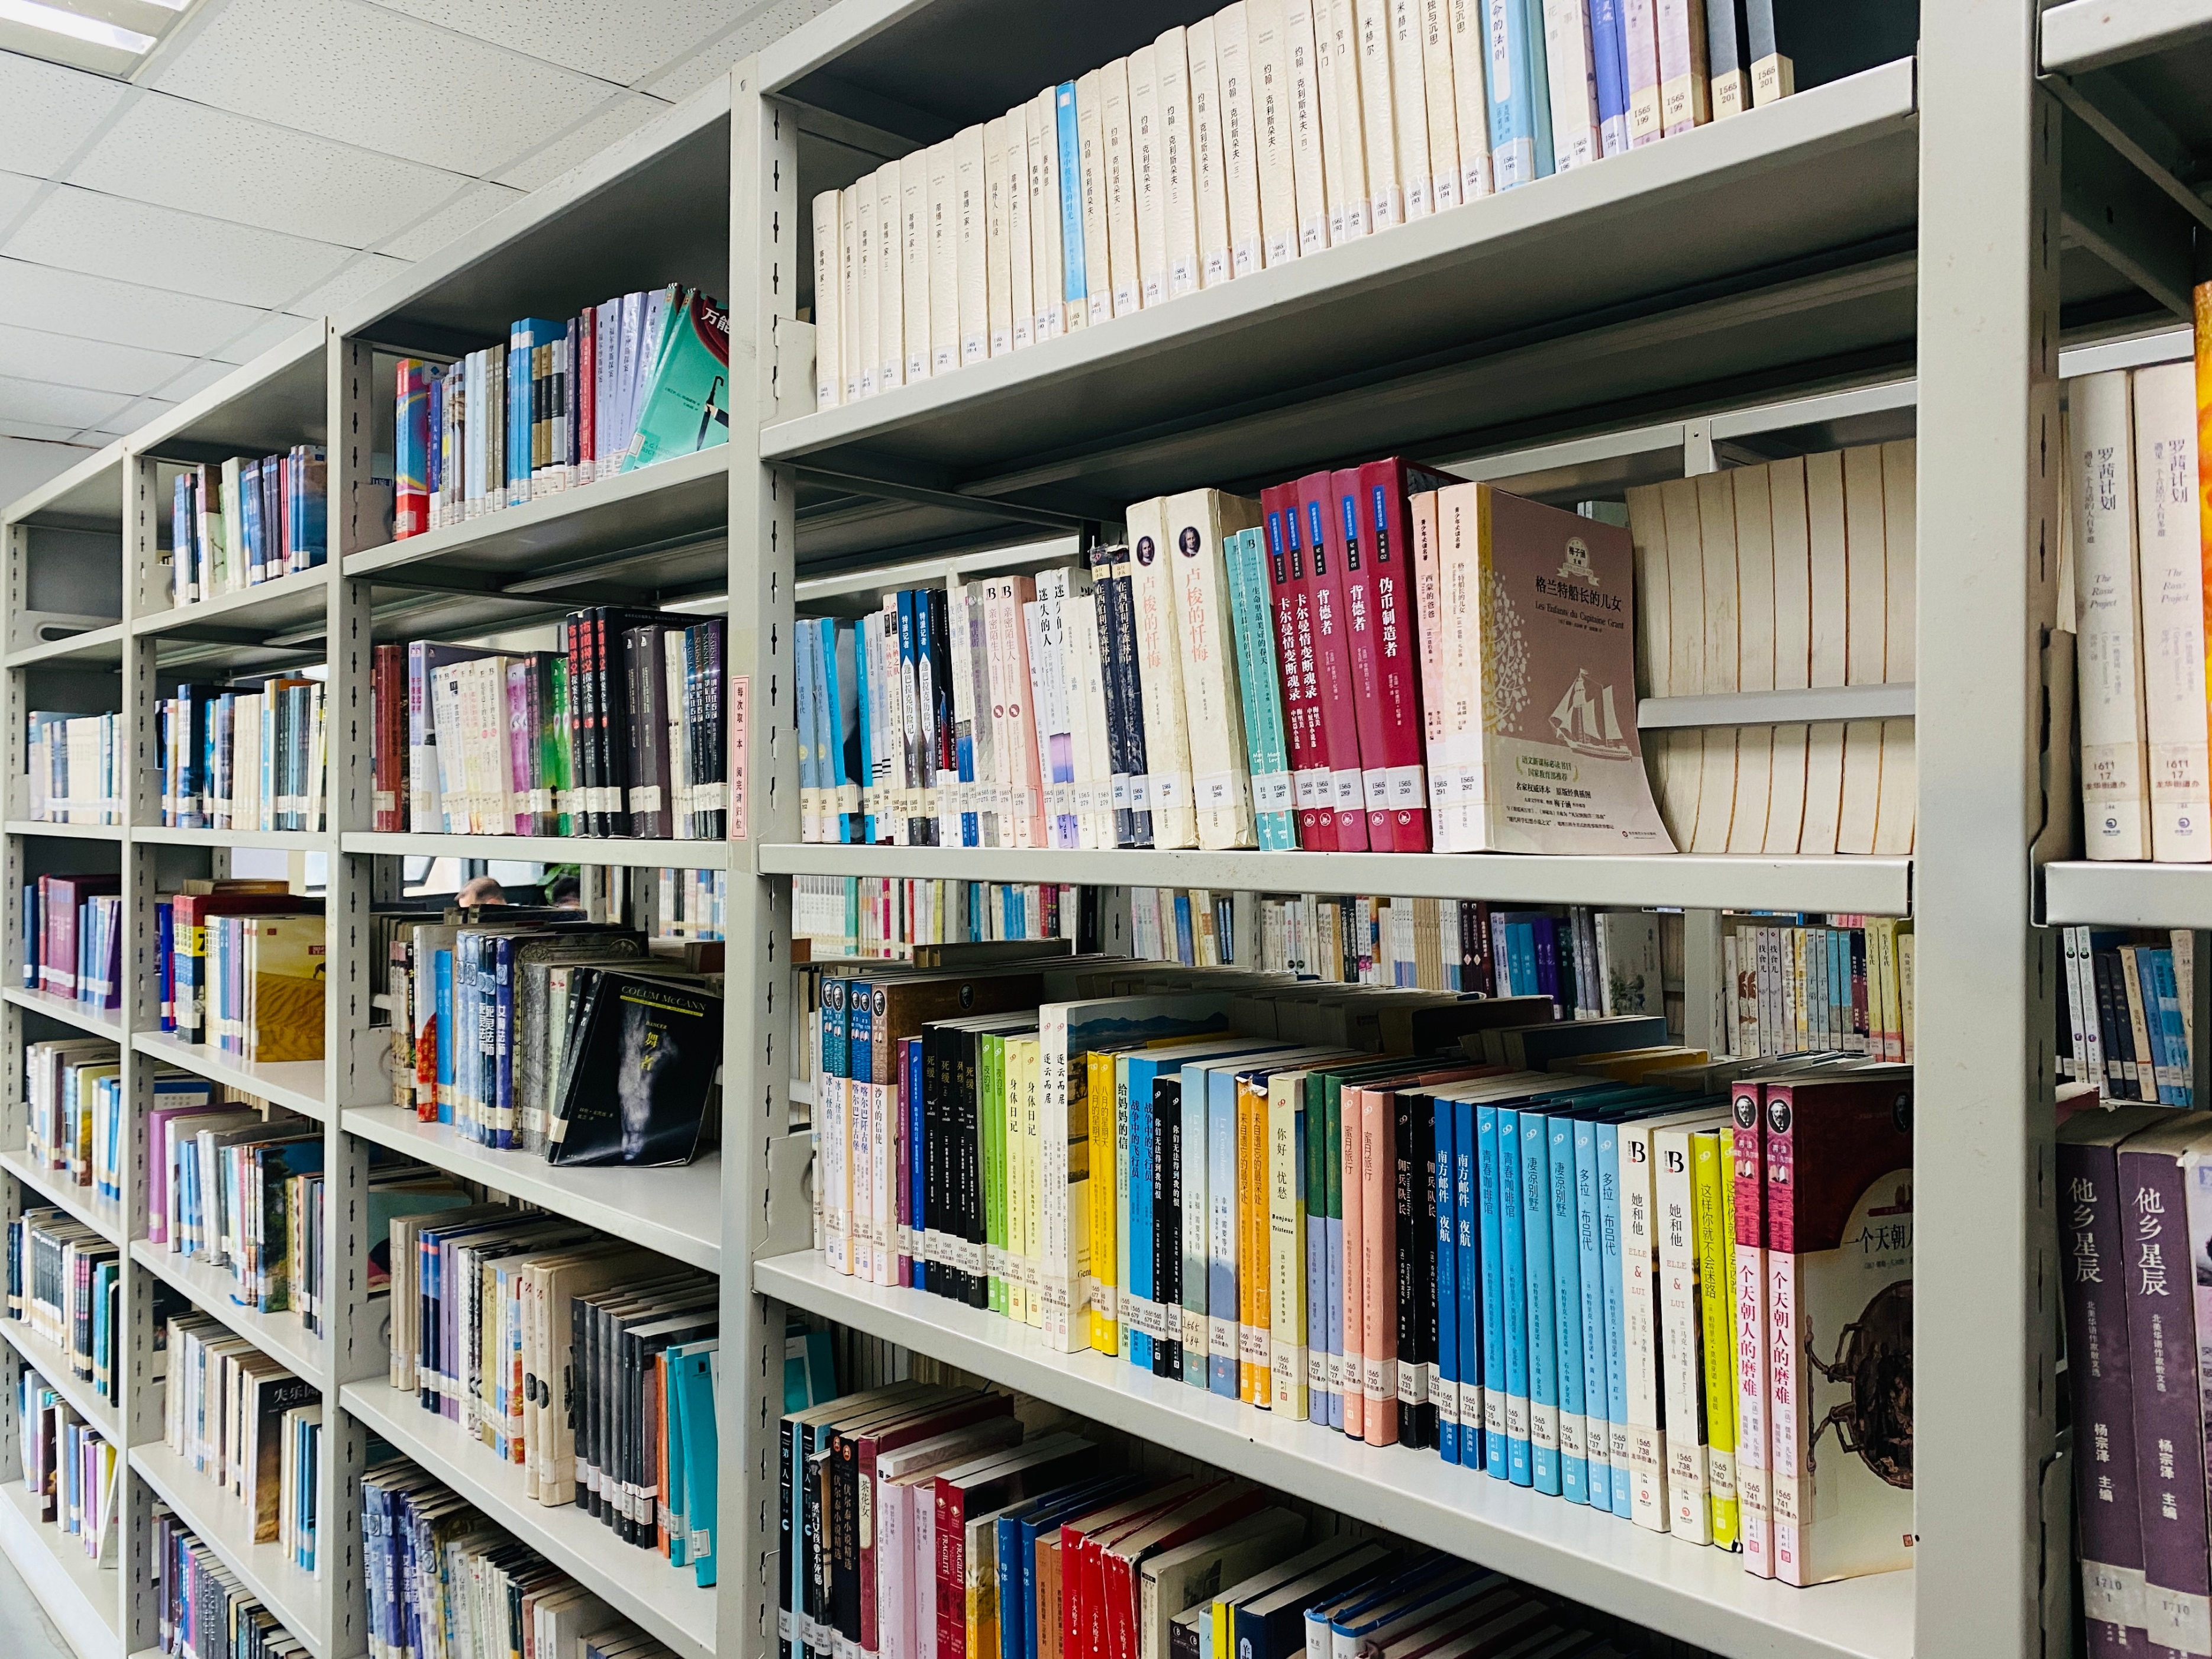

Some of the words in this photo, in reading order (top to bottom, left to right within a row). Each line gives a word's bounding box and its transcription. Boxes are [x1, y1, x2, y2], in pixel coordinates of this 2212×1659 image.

[1722, 93, 1735, 104] 201
[1760, 78, 1773, 88] 201
[1636, 115, 1649, 126] 199
[1670, 103, 1683, 114] 199
[2098, 447, 2116, 511] 罗茜计划
[2168, 439, 2188, 503] 罗茜计划
[1569, 546, 1586, 559] 梅子涵
[2166, 568, 2182, 577] The
[1424, 574, 1435, 619] 西蒙的爸爸
[1535, 575, 1622, 613] 格兰特船长的儿女
[2092, 586, 2114, 596] Rosie
[2095, 573, 2111, 583] The
[2161, 593, 2190, 603] Project
[1039, 589, 1052, 648] 迷失的人
[1118, 581, 1132, 666] 在西伯利亚森林中
[1142, 576, 1161, 669] 卢梭的忏悔
[1186, 567, 1209, 663] 卢梭的忏悔
[1317, 589, 1333, 636] 背德者
[1349, 585, 1366, 632] 背德者
[1379, 577, 1397, 658] 伪币制造者
[1535, 601, 1545, 611] Les
[1546, 603, 1568, 617] Enfants
[1570, 609, 1578, 619] du
[1580, 611, 1606, 627] Capitaine
[1607, 618, 1625, 630] Grant
[2090, 599, 2117, 609] Project
[989, 609, 1000, 662] 亲密陌生人
[1004, 606, 1016, 661] 亲密陌生人
[1096, 584, 1110, 666] 在西伯利亚森林中
[1252, 586, 1268, 665] 生命里最美好的春天
[1278, 597, 1301, 701] 卡尔曼情变断魂录
[1294, 593, 1317, 699] 卡尔曼情变断魂录
[1522, 755, 1572, 771] 语文新课标必读书目
[1528, 768, 1568, 782] 国家教育部推荐
[2100, 771, 2111, 780] 17
[2172, 771, 2183, 780] 17
[1516, 782, 1551, 794] 名家权威译本
[1556, 787, 1591, 799] 原版经典插图
[621, 985, 660, 1000] COLUM
[1044, 1053, 1052, 1105] 逐云而居
[1057, 1053, 1065, 1105] 逐云而居
[860, 1082, 868, 1155] 喀尔巴阡古堡
[1010, 1078, 1018, 1133] 身体日记
[1027, 1080, 1036, 1137] 身体日记
[1118, 1083, 1128, 1150] 给妈妈的信
[1220, 1117, 1226, 1128] La
[1131, 1099, 1140, 1179] 战争中的飞行员
[1144, 1102, 1153, 1182] 战争中的飞行员
[1254, 1112, 1262, 1206] 来自遗忘的最深处
[1344, 1125, 1354, 1175] 蜜月旅行
[1364, 1131, 1373, 1181] 蜜月旅行
[1398, 1158, 1406, 1215] 佣兵队长
[1427, 1161, 1436, 1218] 佣兵队长
[1438, 1150, 1449, 1203] 南方邮件
[1458, 1154, 1470, 1208] 南方邮件
[1483, 1149, 1493, 1215] 青春咖啡馆
[1503, 1151, 1515, 1218] 青春咖啡馆
[1528, 1157, 1539, 1212] 凄凉别墅
[1555, 1161, 1567, 1217] 凄凉别墅
[1272, 1213, 1293, 1224] Bonjour
[1272, 1225, 1294, 1235] Tristesse
[1439, 1215, 1450, 1242] 夜航
[1459, 1219, 1471, 1247] 夜航
[1631, 1193, 1644, 1236] 她和他
[1668, 1203, 1683, 1247] 她和他
[2069, 1177, 2104, 1284] 他乡星辰
[1628, 1248, 1647, 1258] ELLE
[1700, 1183, 1716, 1299] 这样你就不会迷路
[2132, 1187, 2171, 1296] 他乡星辰
[1635, 1266, 1642, 1277] &
[1667, 1260, 1687, 1269] ELLE
[1674, 1278, 1681, 1290] &
[1632, 1286, 1645, 1296] LUI
[1670, 1299, 1685, 1309] LUI
[1185, 1333, 1200, 1346] 684
[1739, 1254, 1757, 1397] 一个天朝人的磨难
[1772, 1261, 1791, 1405] 一个天朝人的磨难
[2087, 1301, 2101, 1378] 北美华语作家散文选
[2152, 1313, 2166, 1393] 北美华语作家散文选
[1367, 1376, 1377, 1385] 730
[1400, 1380, 1411, 1389] 733
[1464, 1403, 1474, 1412] 734
[1533, 1424, 1544, 1432] 736
[1561, 1432, 1571, 1442] 736
[1613, 1441, 1624, 1450] 737
[1638, 1446, 1650, 1455] 738
[2094, 1422, 2110, 1463] 杨宗泽
[781, 1447, 790, 1479] 第一人
[1678, 1461, 1690, 1471] 738
[1712, 1470, 1725, 1480] 740
[2158, 1438, 2175, 1479] 杨宗泽
[861, 1480, 870, 1518] 茶花女
[1746, 1490, 1758, 1501] 741
[1777, 1497, 1788, 1509] 741
[2098, 1476, 2113, 1503] 主编
[2162, 1492, 2178, 1521] 主编
[844, 1483, 852, 1571] 伏尔泰小说精选
[1119, 1612, 1127, 1651] 三个火枪手
